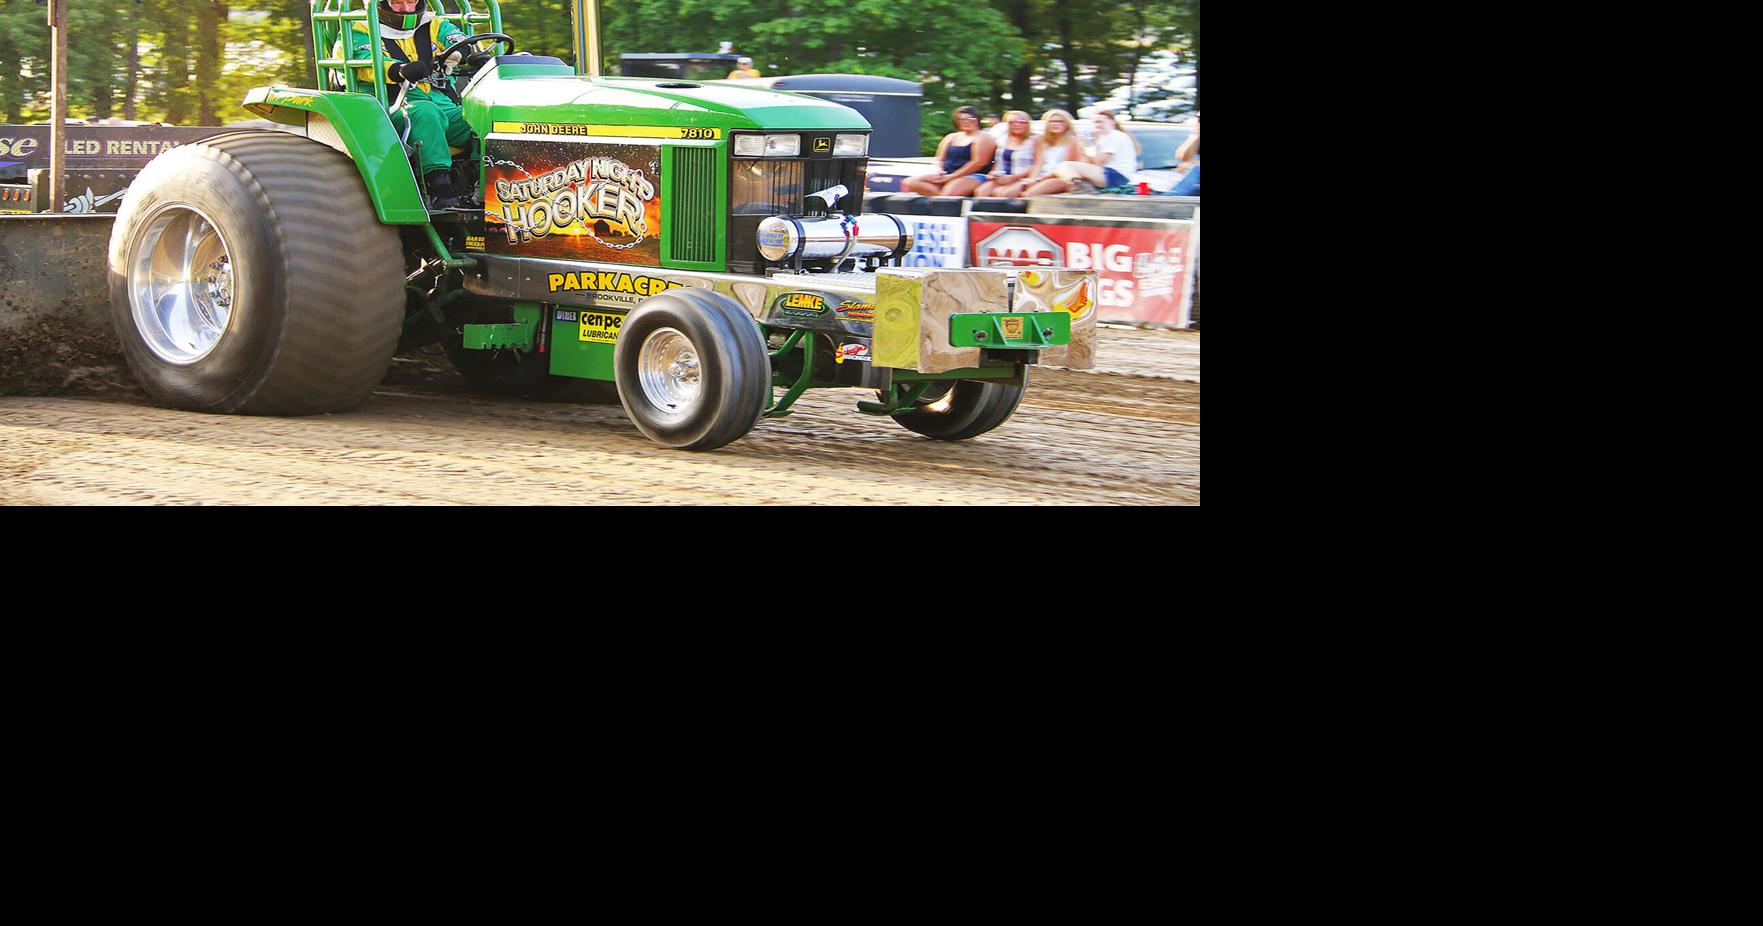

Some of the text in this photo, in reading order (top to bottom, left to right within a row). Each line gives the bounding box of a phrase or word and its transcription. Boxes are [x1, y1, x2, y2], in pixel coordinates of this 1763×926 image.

[520, 123, 588, 137] JOHN DEERE
[680, 127, 715, 140] 7810
[62, 139, 100, 156] LED
[107, 139, 181, 156] RENTA
[495, 156, 655, 203] SATURDAY NIGHT
[501, 180, 644, 244] HOOKER
[1067, 241, 1134, 273] BIG
[547, 271, 688, 299] PARKACR
[1097, 277, 1135, 308] GS
[785, 292, 824, 310] LEMKE
